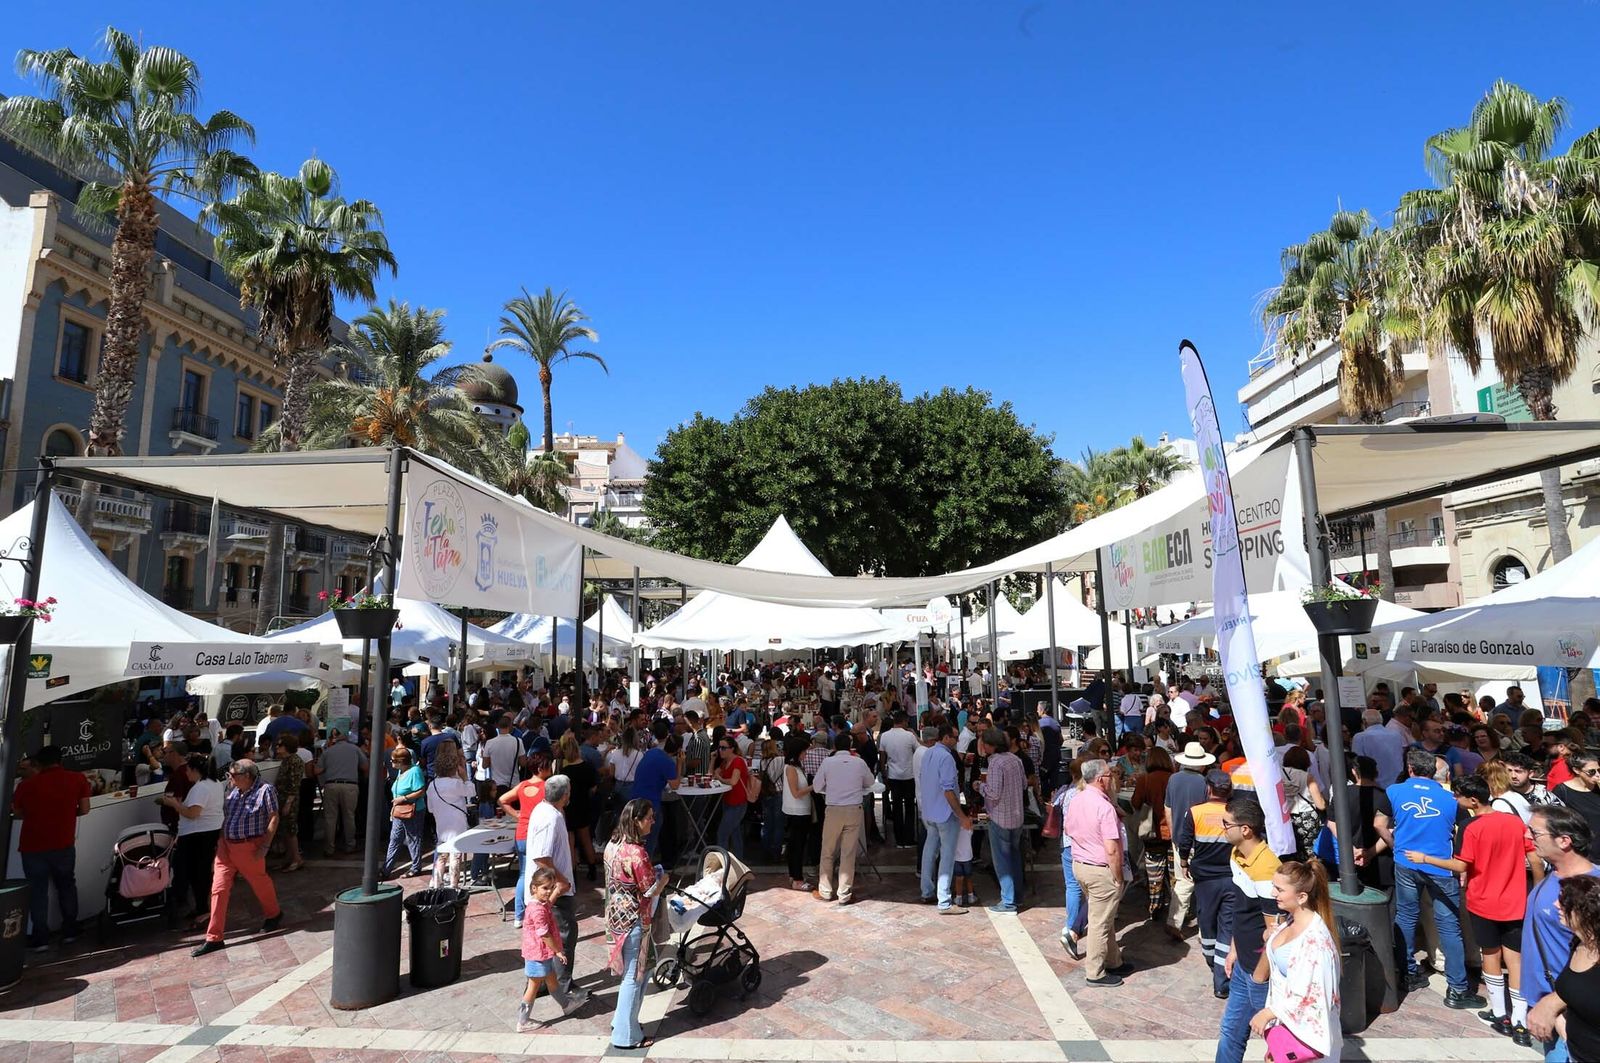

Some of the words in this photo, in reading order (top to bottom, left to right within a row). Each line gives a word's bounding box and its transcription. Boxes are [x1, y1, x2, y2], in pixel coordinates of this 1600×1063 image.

[497, 570, 527, 592] HUELVA
[1410, 640, 1420, 653] El
[1421, 640, 1459, 654] Paraíso
[1462, 640, 1477, 654] de
[1479, 640, 1535, 656] Gonzalo
[195, 652, 225, 666] Casa
[228, 652, 252, 666] Lalo
[254, 651, 289, 665] Taberna
[131, 662, 152, 671] CASA
[153, 662, 174, 671] LALO
